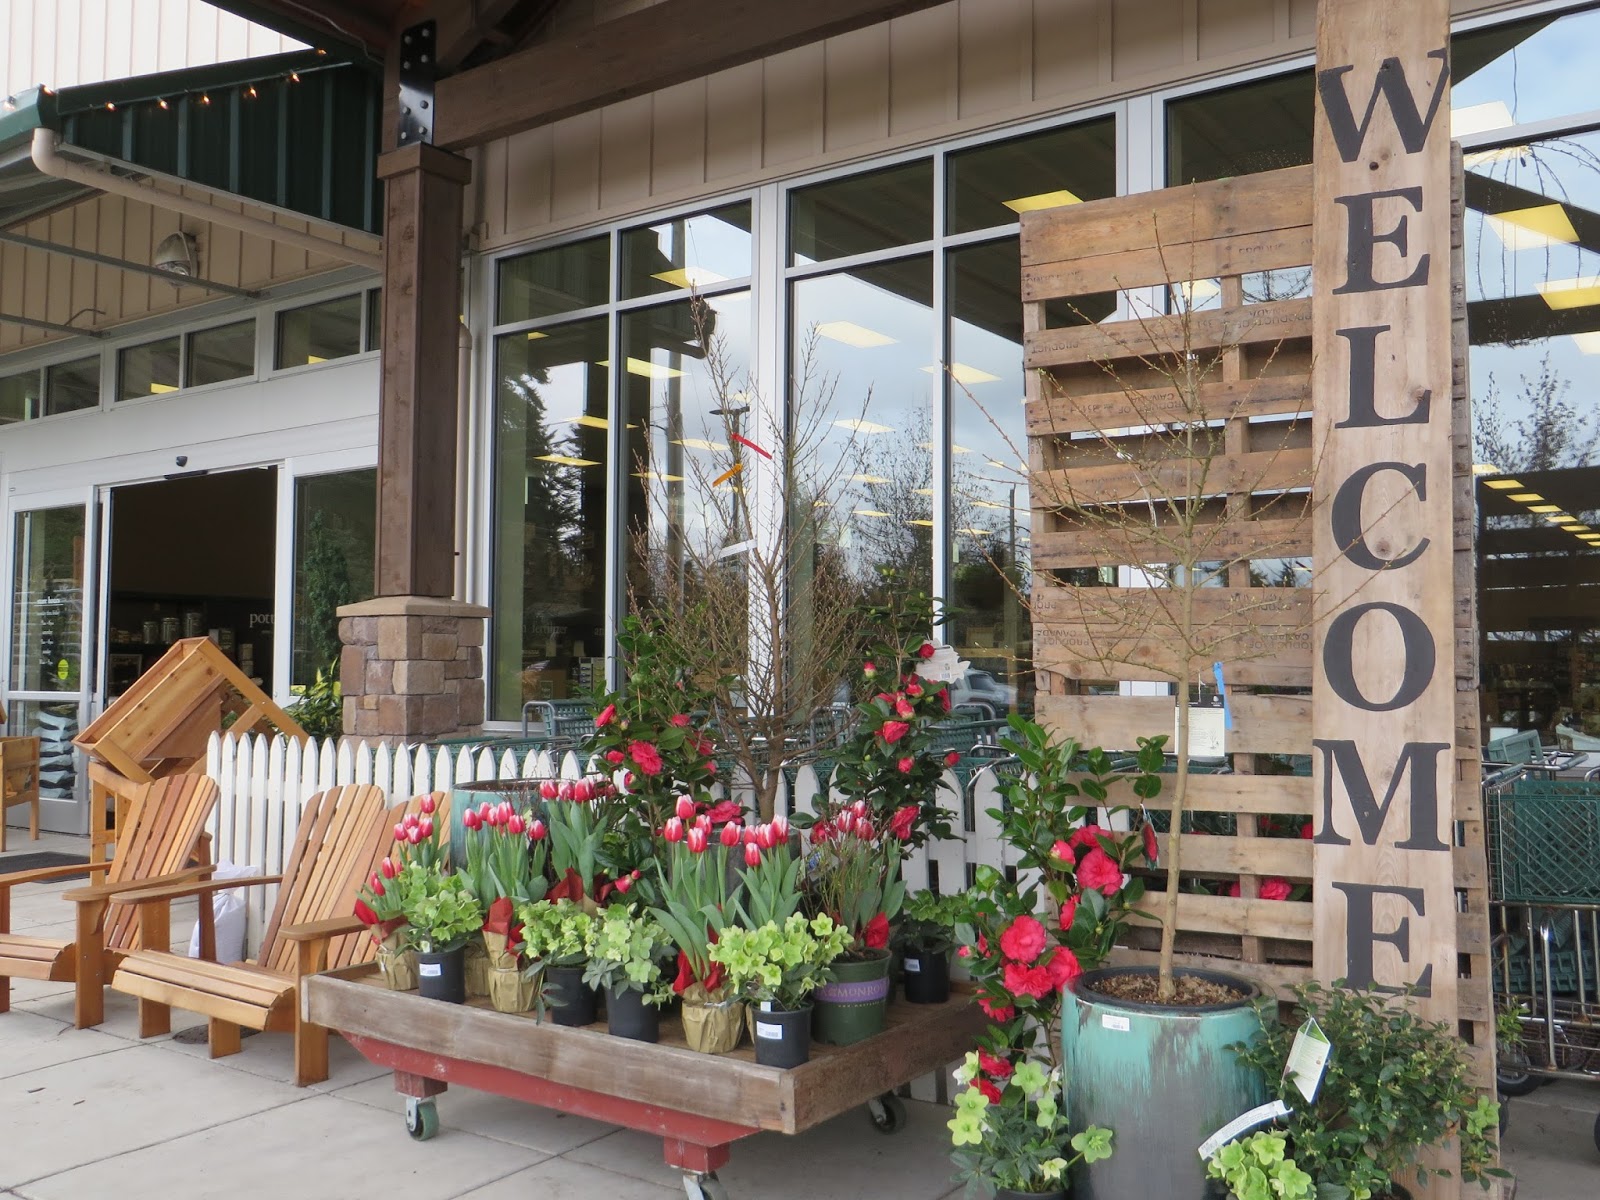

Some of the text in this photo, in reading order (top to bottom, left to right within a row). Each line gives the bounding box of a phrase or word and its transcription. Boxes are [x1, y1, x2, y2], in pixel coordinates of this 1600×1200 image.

[1031, 340, 1079, 355] PRODUCT
[1313, 48, 1451, 998] WELCOME
[1037, 629, 1077, 637] CANADA
[1043, 637, 1090, 646] PRODUCT
[837, 982, 886, 998] MONROV
